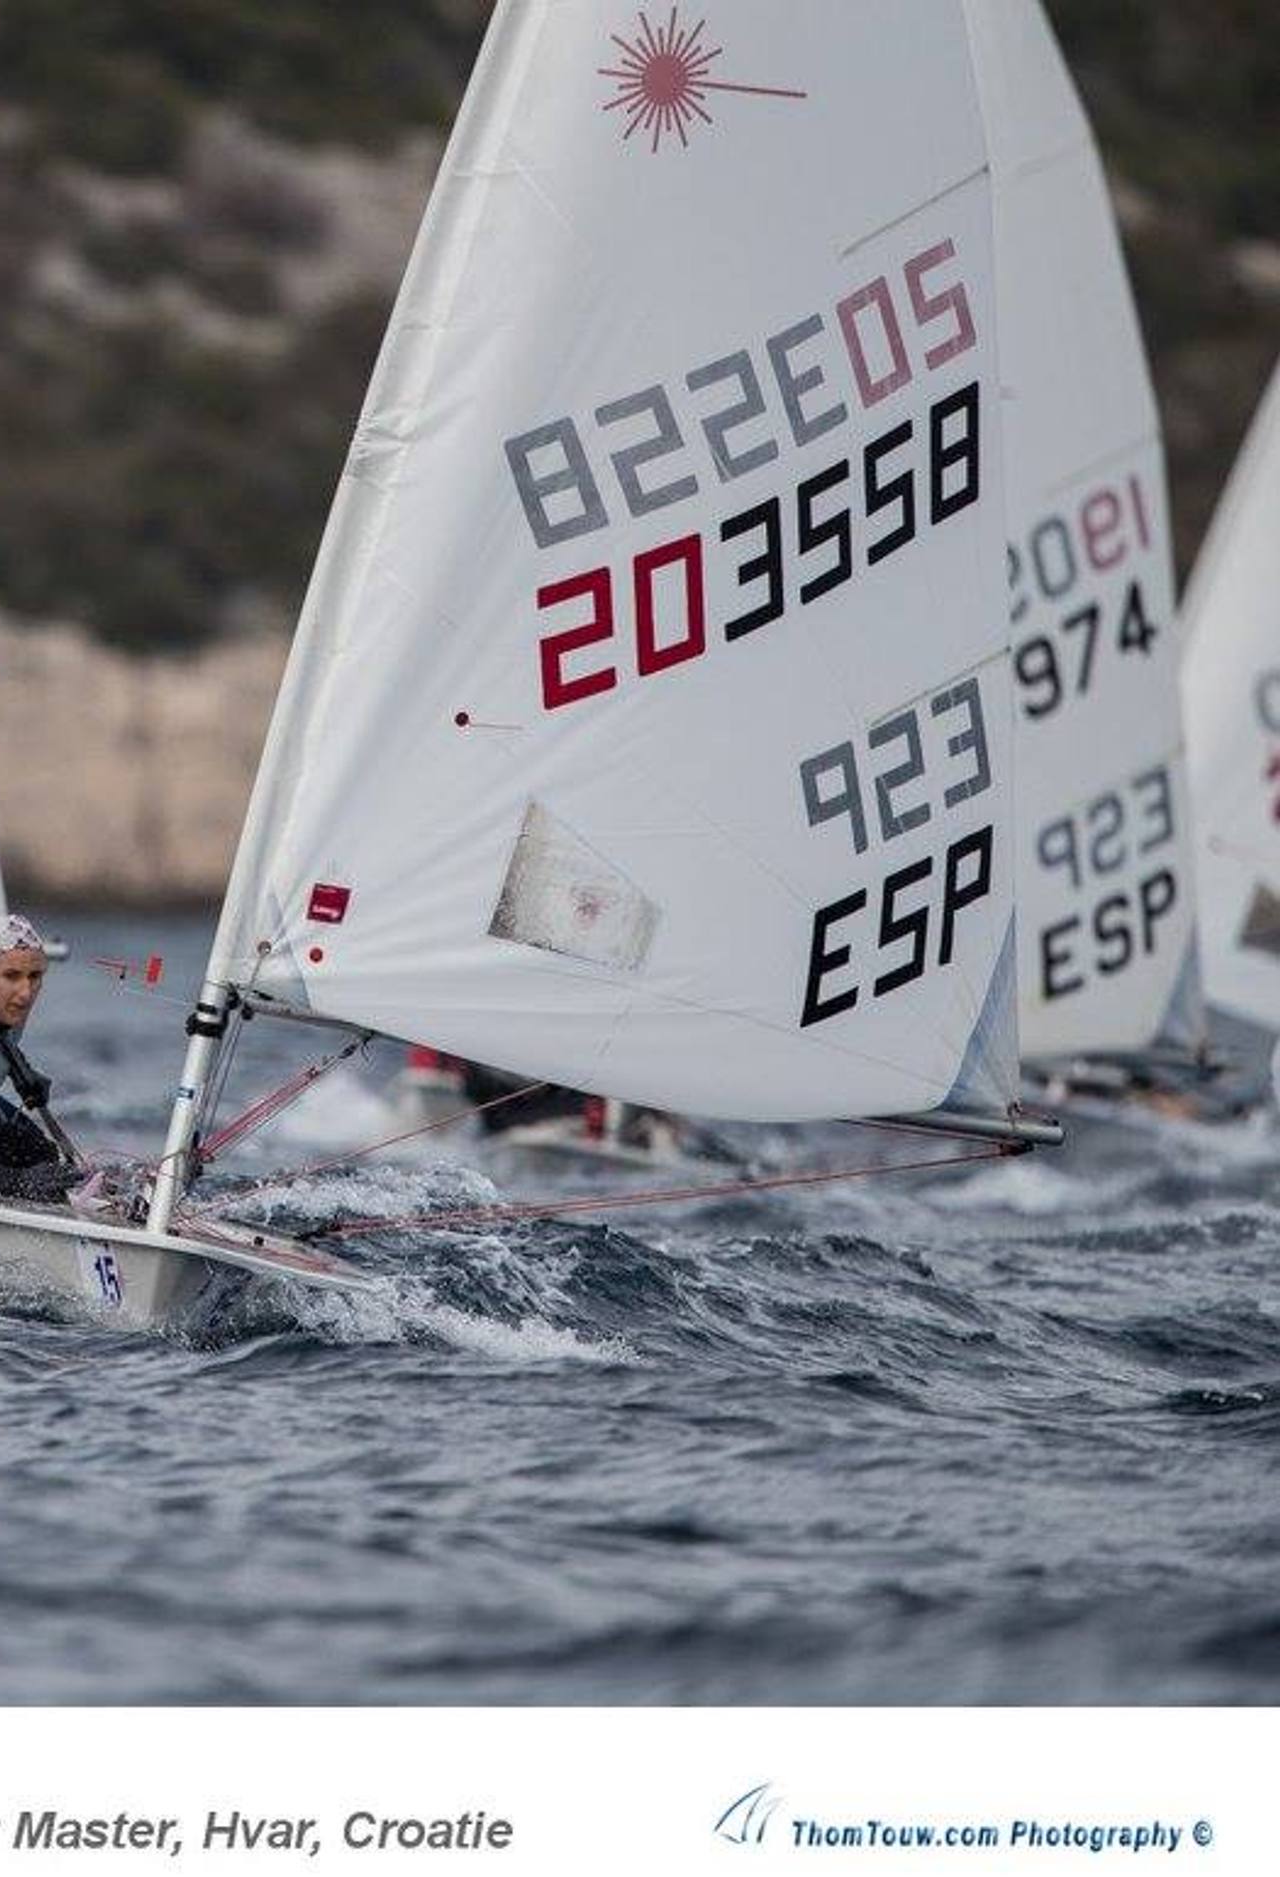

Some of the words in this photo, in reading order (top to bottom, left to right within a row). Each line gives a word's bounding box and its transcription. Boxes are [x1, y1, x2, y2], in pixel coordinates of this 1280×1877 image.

[536, 381, 979, 711] 203558
[1014, 577, 1158, 720] 974
[800, 824, 994, 1027] ESP
[1041, 866, 1178, 1002] ESP
